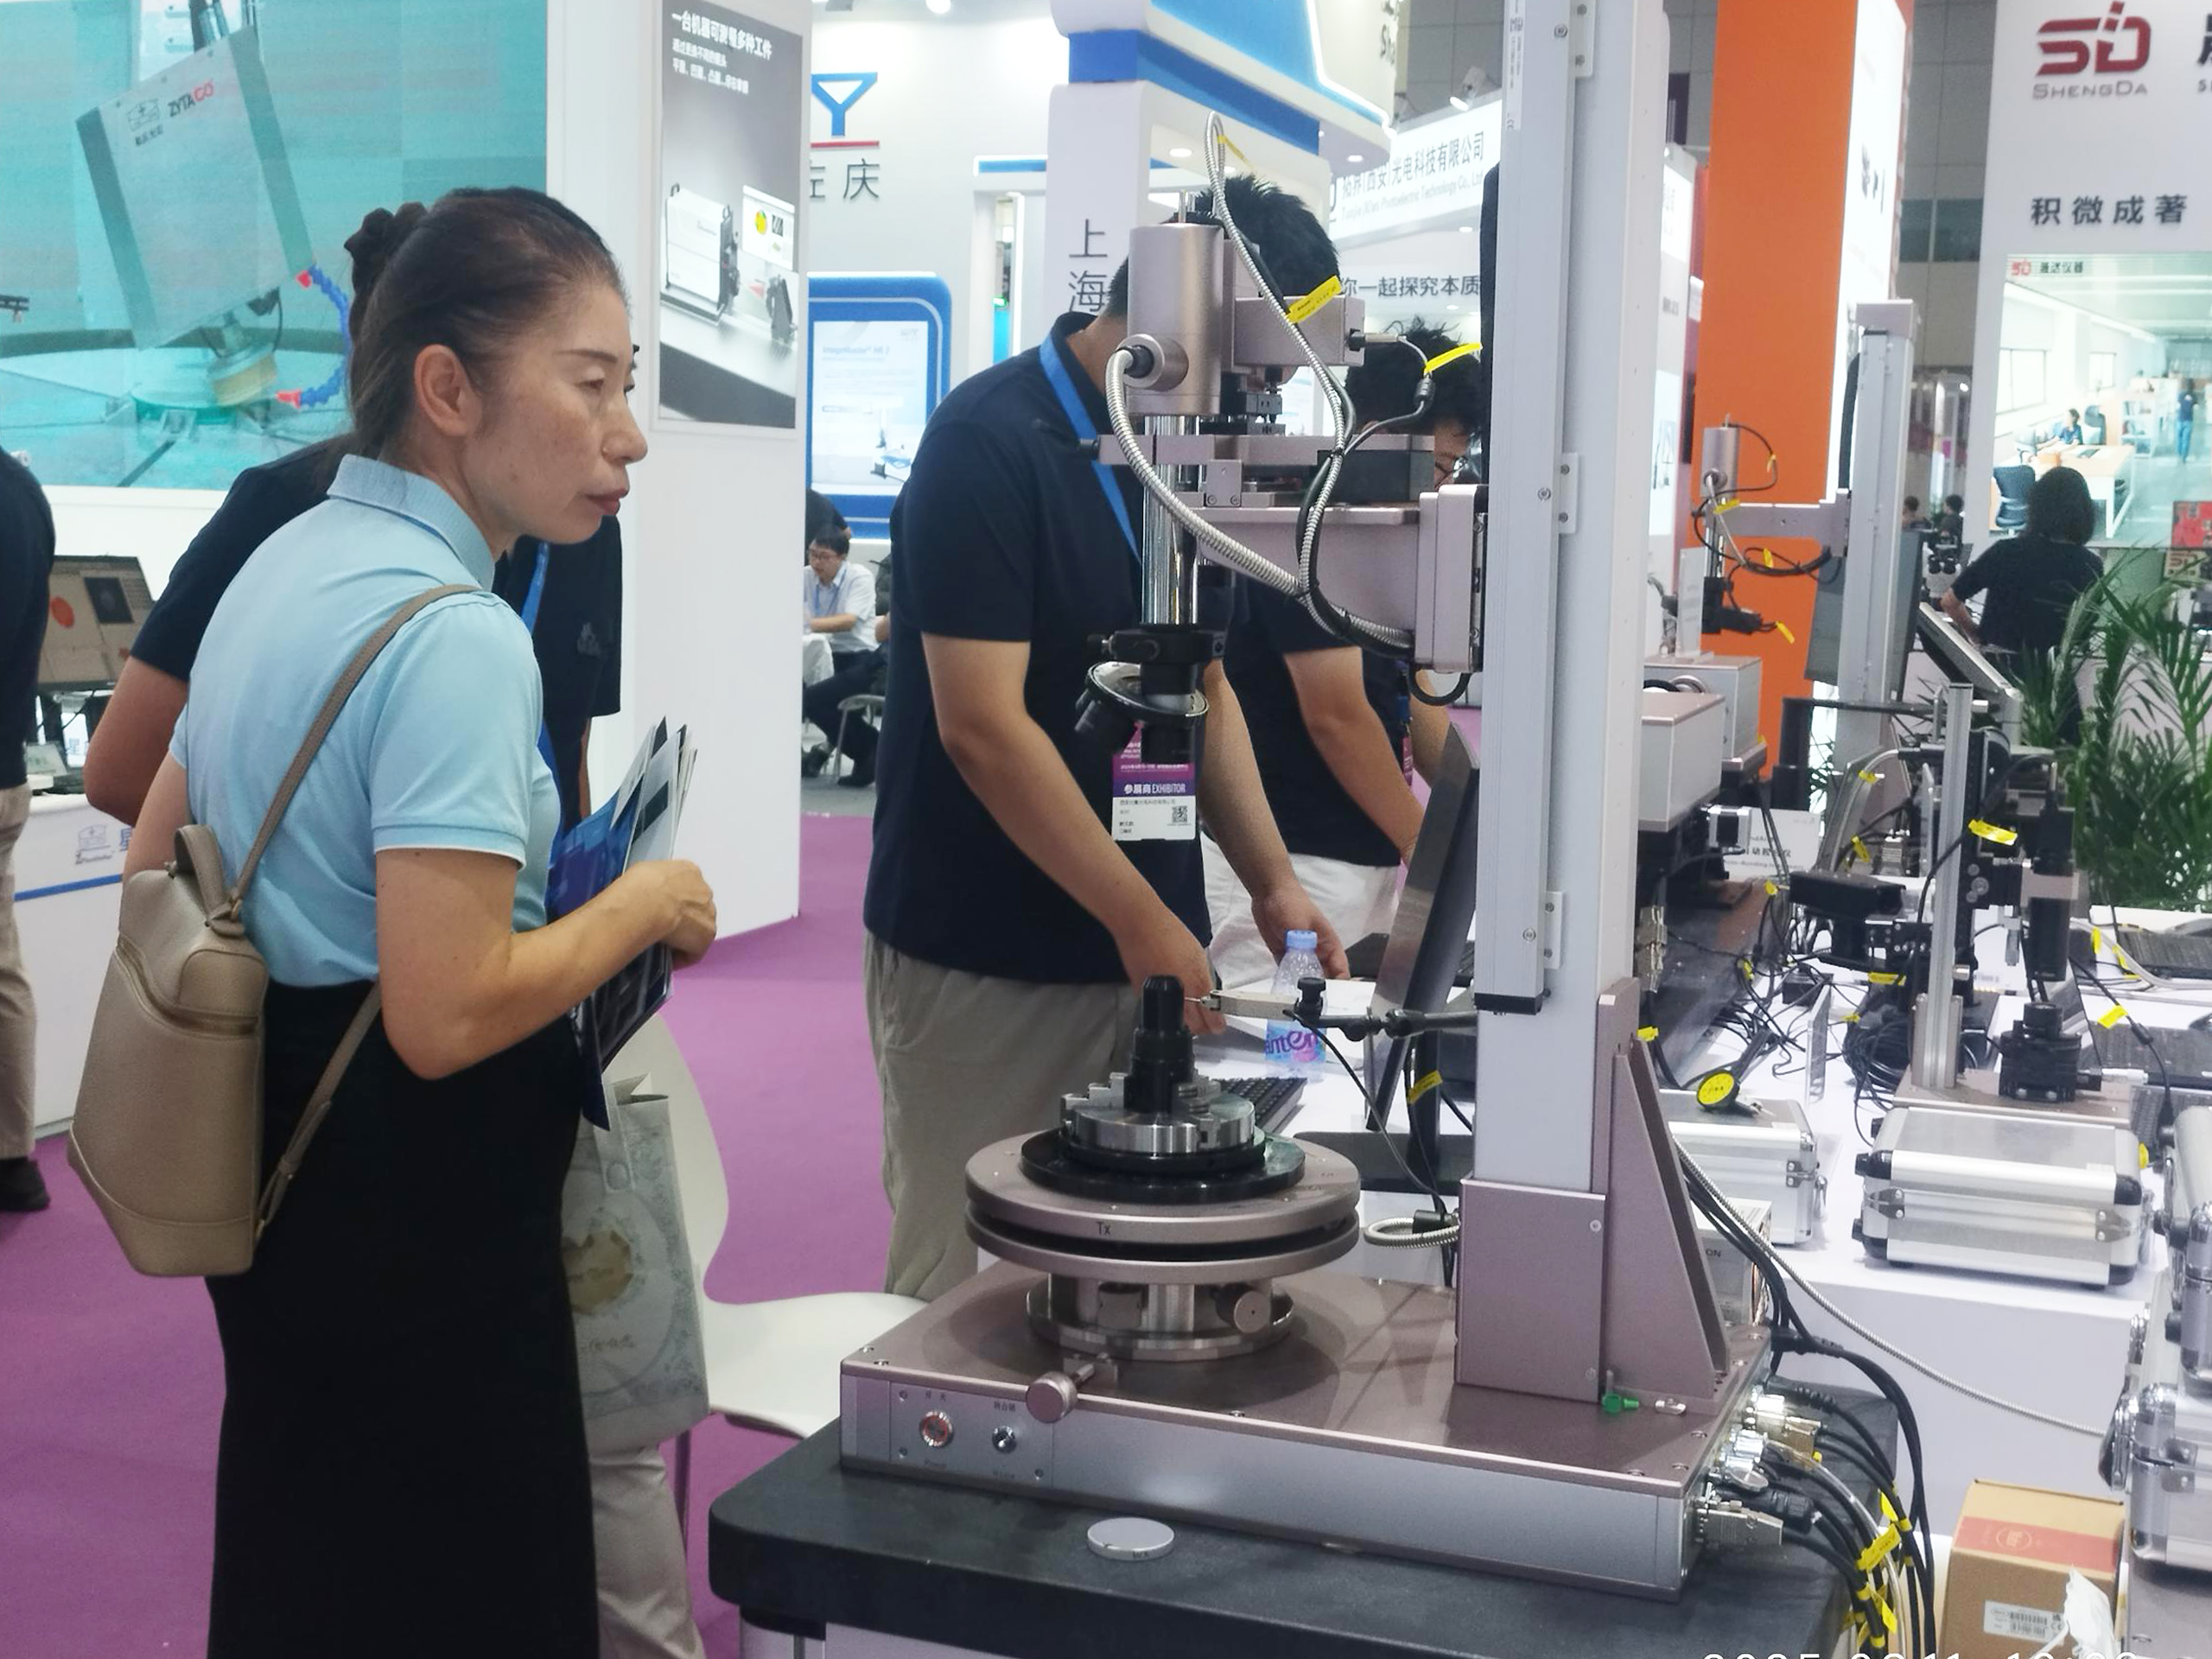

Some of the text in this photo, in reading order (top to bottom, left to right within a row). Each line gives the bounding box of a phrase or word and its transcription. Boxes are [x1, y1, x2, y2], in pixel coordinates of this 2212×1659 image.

[2031, 194, 2187, 226] 积微成著
[1152, 784, 1185, 793] EXHIBITOR
[1096, 1221, 1111, 1235] Tx
